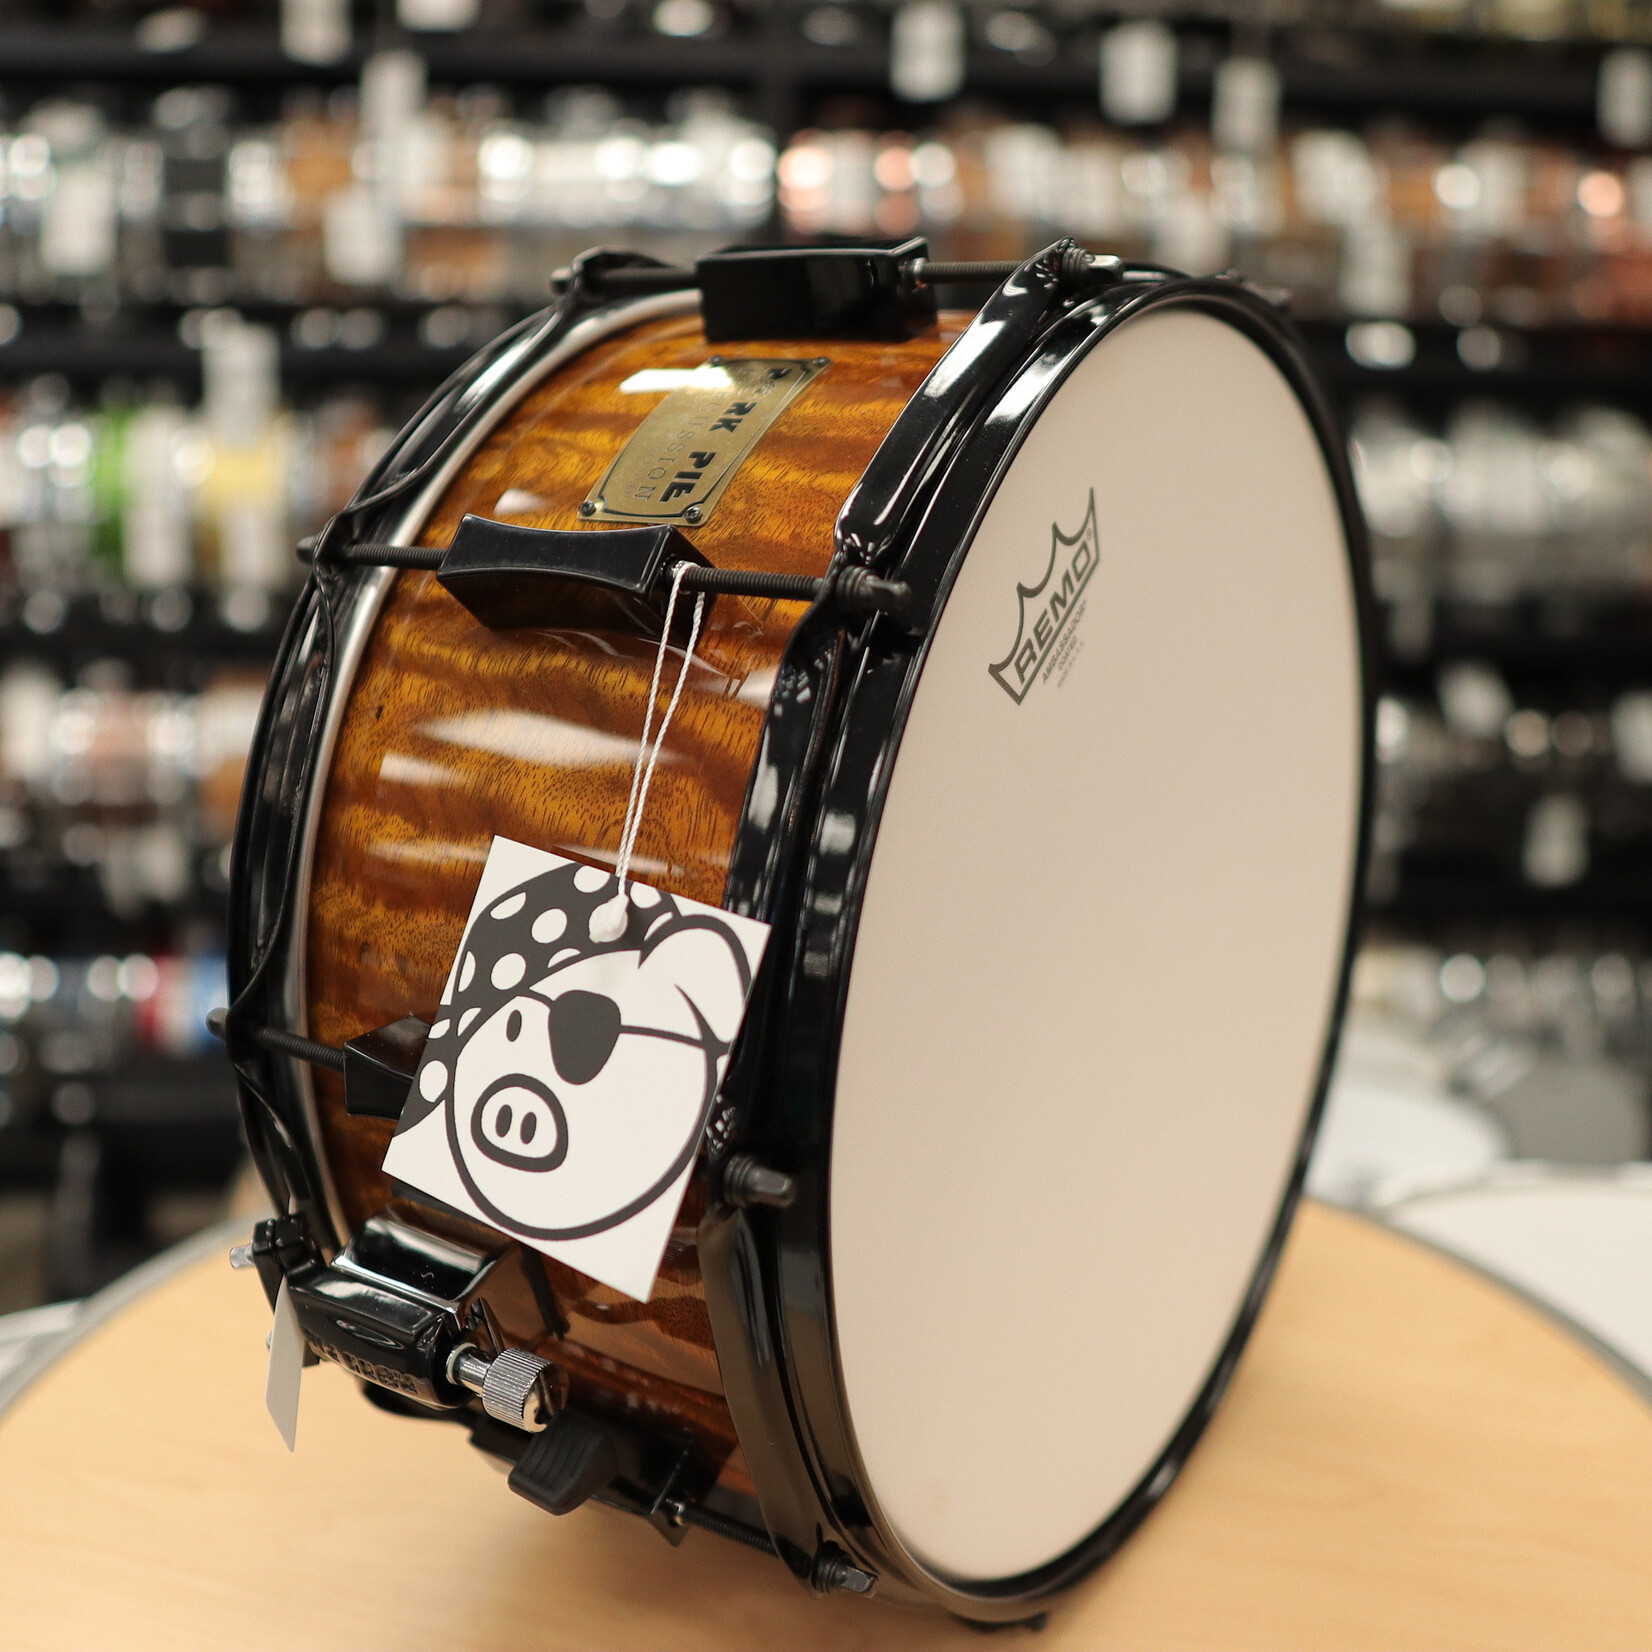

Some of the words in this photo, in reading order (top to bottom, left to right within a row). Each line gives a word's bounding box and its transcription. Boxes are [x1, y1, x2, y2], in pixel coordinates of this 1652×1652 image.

[658, 451, 717, 503] PIE
[1014, 540, 1091, 685] REMO
[1042, 600, 1086, 684] AMBASSADOR
[1057, 635, 1078, 670] COATED
